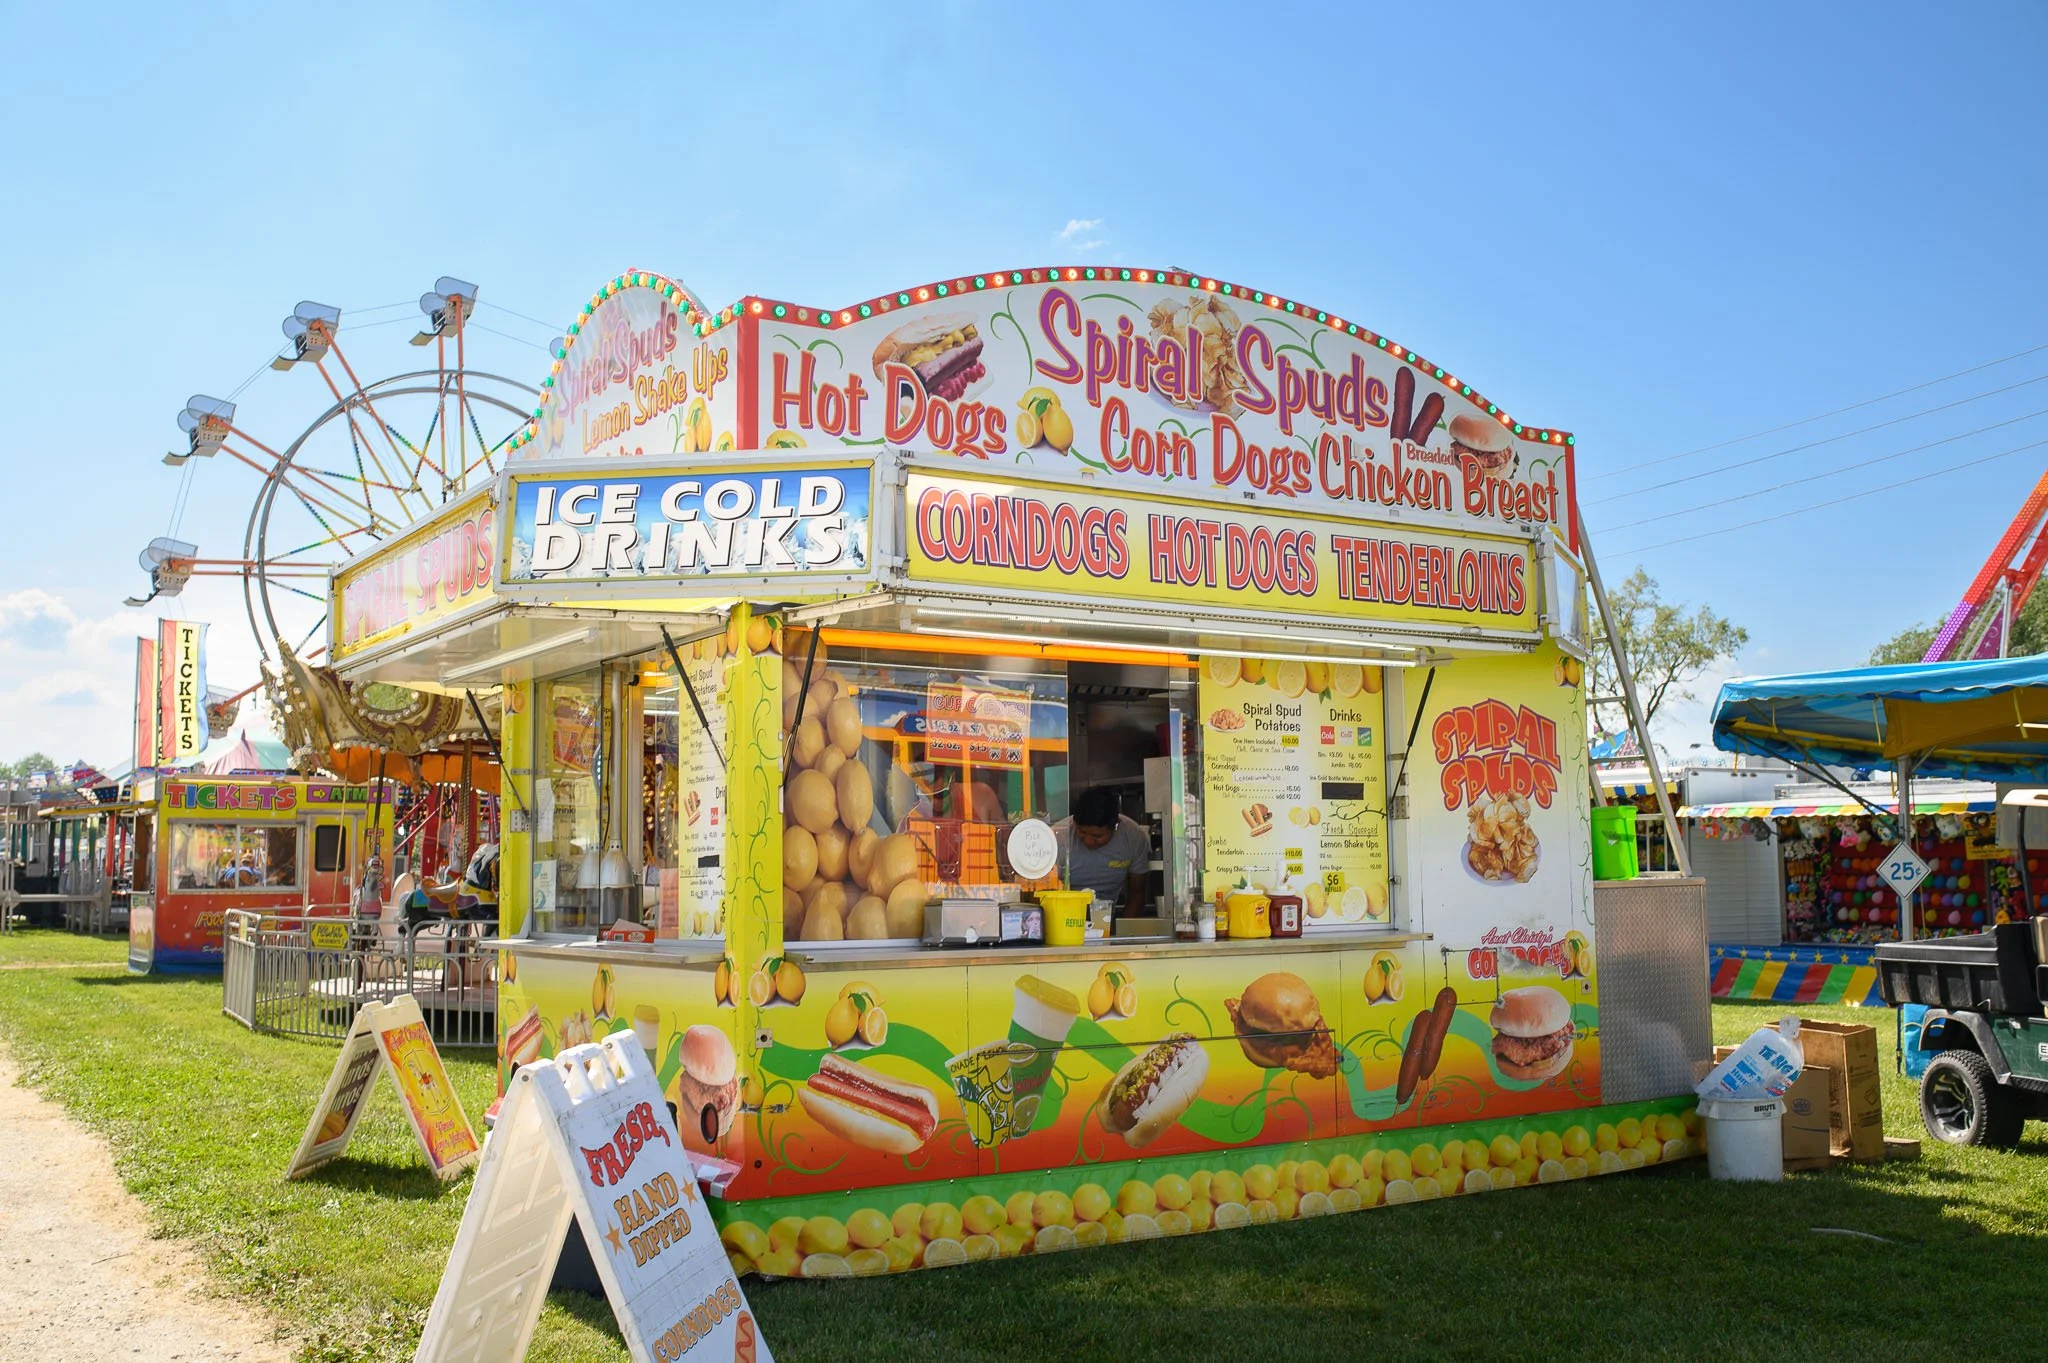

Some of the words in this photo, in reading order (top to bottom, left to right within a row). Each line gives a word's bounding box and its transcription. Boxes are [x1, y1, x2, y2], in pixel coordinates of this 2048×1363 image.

[558, 339, 609, 425] Spiral
[612, 301, 677, 390] Spuds
[1035, 287, 1203, 408] Spiral
[1233, 324, 1389, 436] Spuds
[582, 402, 630, 454] Lemon
[634, 365, 687, 425] Shake
[693, 342, 728, 401] Ups
[772, 350, 868, 436] Hot
[883, 361, 1008, 460] Dogs
[1100, 396, 1196, 480] Corn
[1210, 412, 1312, 496] Dogs
[1406, 444, 1456, 466] Breaded
[536, 484, 640, 526] ICE
[661, 475, 846, 523] COLD
[1319, 432, 1451, 512] Chicken
[1461, 453, 1559, 524] Breast
[531, 517, 846, 573] DRINKS
[916, 487, 1129, 579] CORNDOGS
[1148, 513, 1221, 588] HOT
[1218, 523, 1318, 596] DOGS
[1331, 534, 1526, 616] TENDERLOINS
[343, 558, 409, 646] SPIRAL
[416, 509, 495, 615] SPUDS
[178, 628, 193, 750] TICKETS
[1243, 702, 1272, 718] Spiral
[1276, 704, 1302, 720] Spud
[1330, 709, 1362, 722] Drinks
[1255, 719, 1301, 732] Potatoes
[1432, 698, 1561, 772] SPIRAL
[166, 783, 297, 811] TICKETS
[329, 786, 368, 802] ATM
[1225, 784, 1240, 793] Dogs
[1440, 750, 1560, 811] SPUDS
[1320, 840, 1342, 848] Lemon
[1344, 840, 1364, 848] Shake
[1366, 840, 1379, 850] Ups
[1321, 822, 1344, 834] Fresh
[1349, 822, 1378, 837] Squeezed
[1327, 874, 1339, 886] $6
[1890, 862, 1922, 881] 25¢
[1481, 926, 1511, 945] Aunt
[1509, 925, 1553, 950] Christy's
[1754, 1103, 1776, 1113] BRUTE
[613, 1171, 679, 1236] HAND
[629, 1208, 692, 1268] DIPPED
[651, 1278, 742, 1363] CORNDOGS
